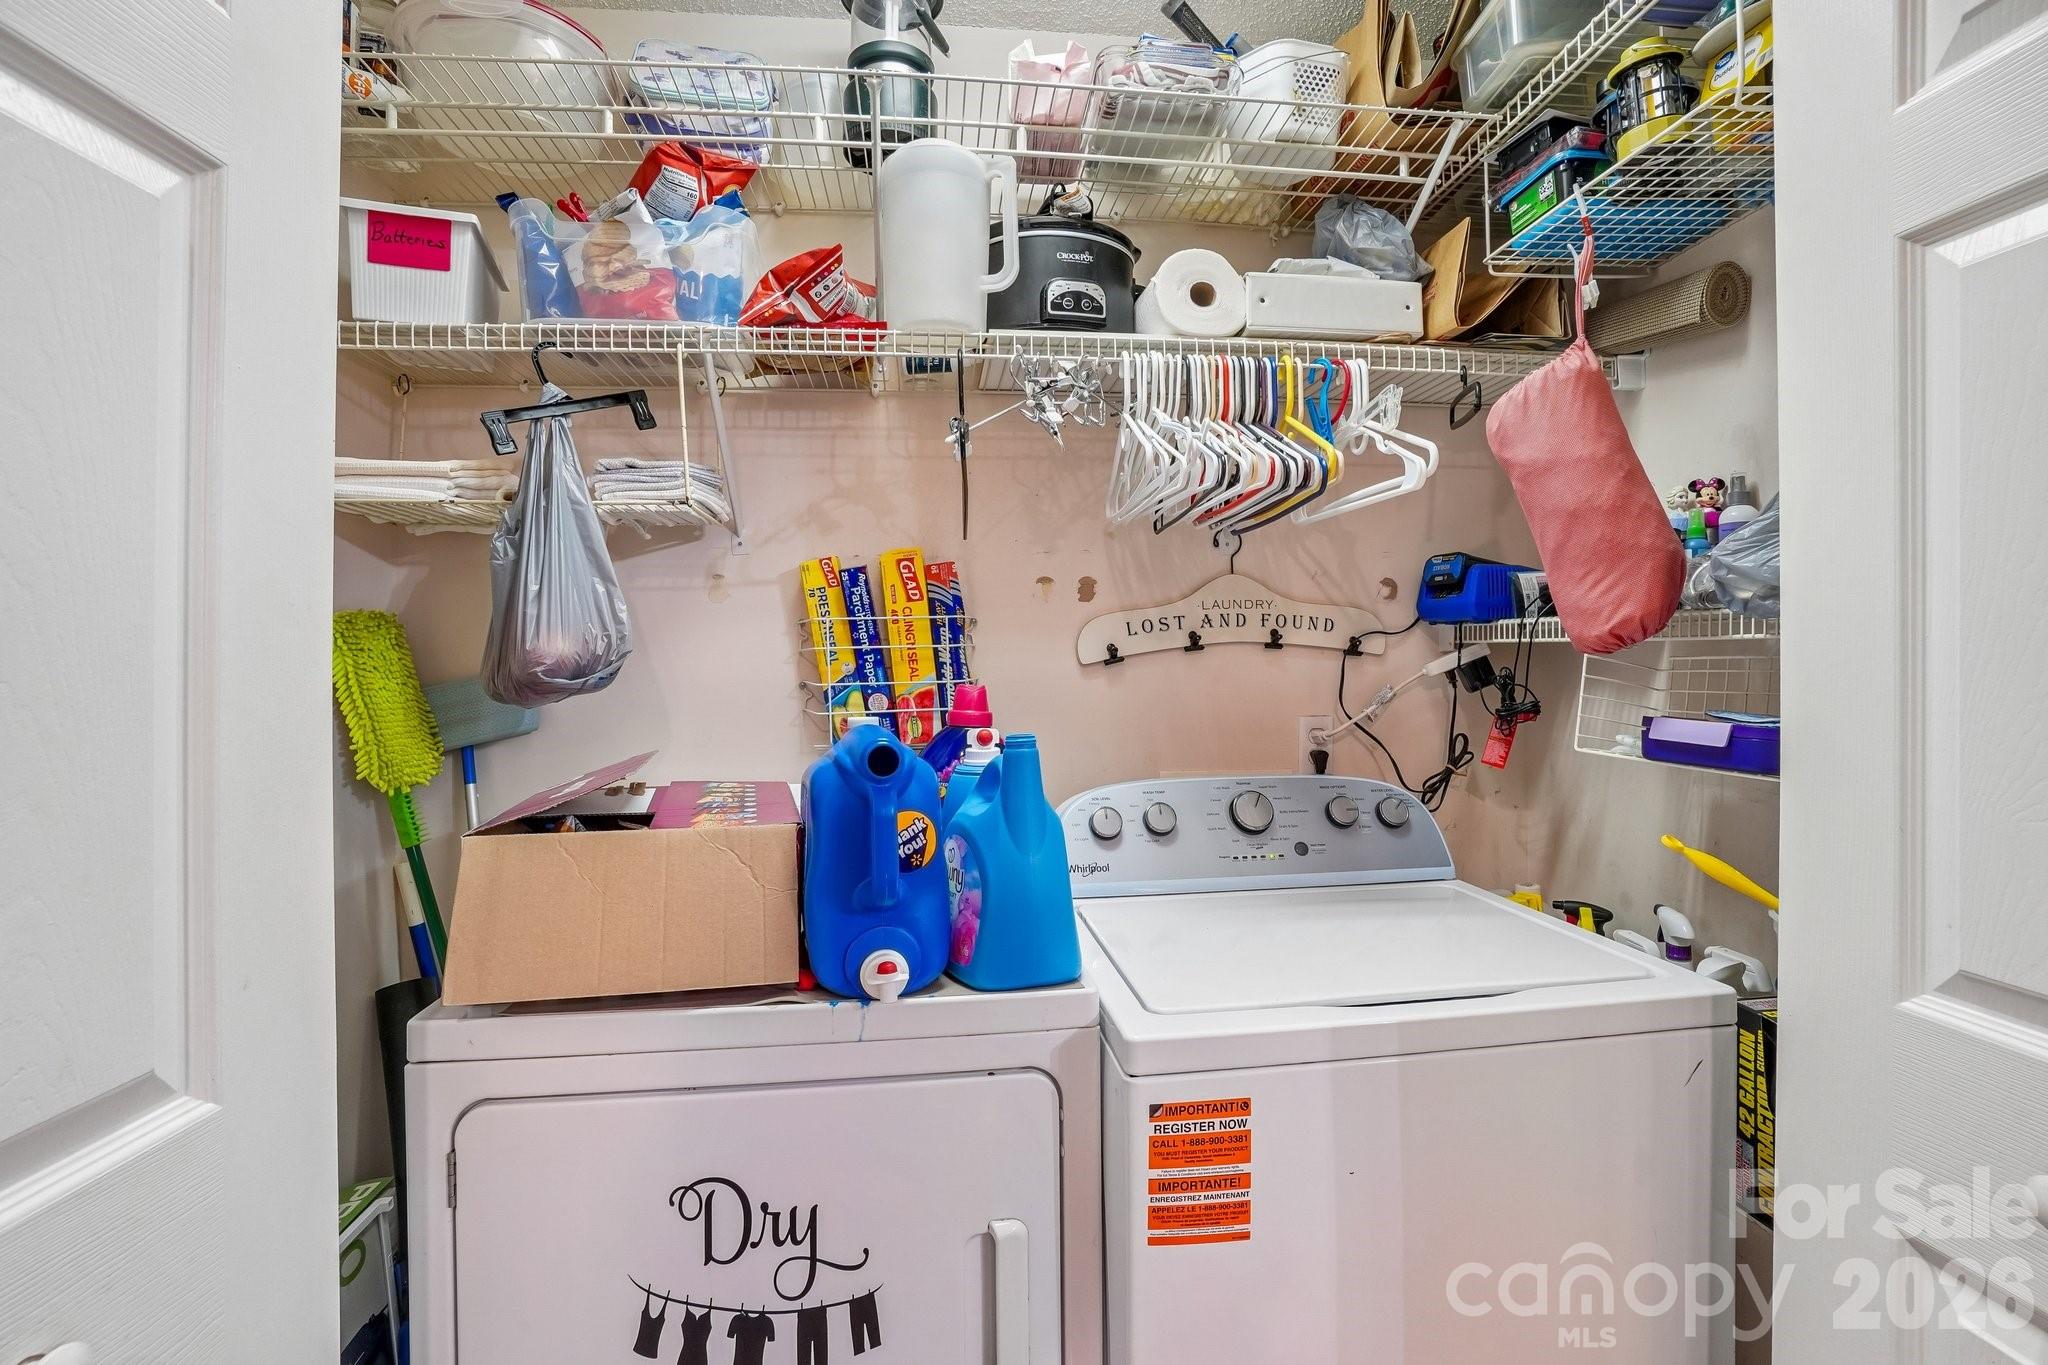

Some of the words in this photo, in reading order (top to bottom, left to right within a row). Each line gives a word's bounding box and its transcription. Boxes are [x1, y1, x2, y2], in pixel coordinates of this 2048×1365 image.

[371, 220, 446, 249] Batteries
[821, 559, 838, 587] GLAD
[841, 571, 849, 581] 25
[900, 560, 921, 600] GLAD
[808, 588, 816, 598] 70
[857, 573, 870, 605] Reynolds
[1201, 599, 1273, 611] LAUNDRY
[1125, 616, 1186, 637] LOST
[1200, 612, 1247, 629] AND
[1260, 613, 1335, 633] FOUND
[850, 587, 872, 652] Parchment
[863, 653, 878, 689] Paper
[908, 651, 921, 682] SEAL
[898, 818, 927, 844] ank
[1069, 863, 1110, 877] Whirlpool
[1738, 1028, 1757, 1104] GALLON
[1165, 1102, 1239, 1116] IMPORTANT!
[1153, 1121, 1215, 1134] REGISTER
[1219, 1118, 1248, 1130] NOW
[1738, 1107, 1753, 1139] 42
[1152, 1139, 1178, 1148] CALL
[1181, 1135, 1248, 1147] 1-888-900-3381
[1150, 1194, 1202, 1203] ENREGISTREZ
[1203, 1191, 1250, 1201] MAINTENANT
[1158, 1177, 1241, 1192] IMPORTANTE!
[1151, 1206, 1185, 1214] APPELEZ
[1198, 1202, 1248, 1211] 1-888-900-3381
[669, 1177, 869, 1301] Dry
